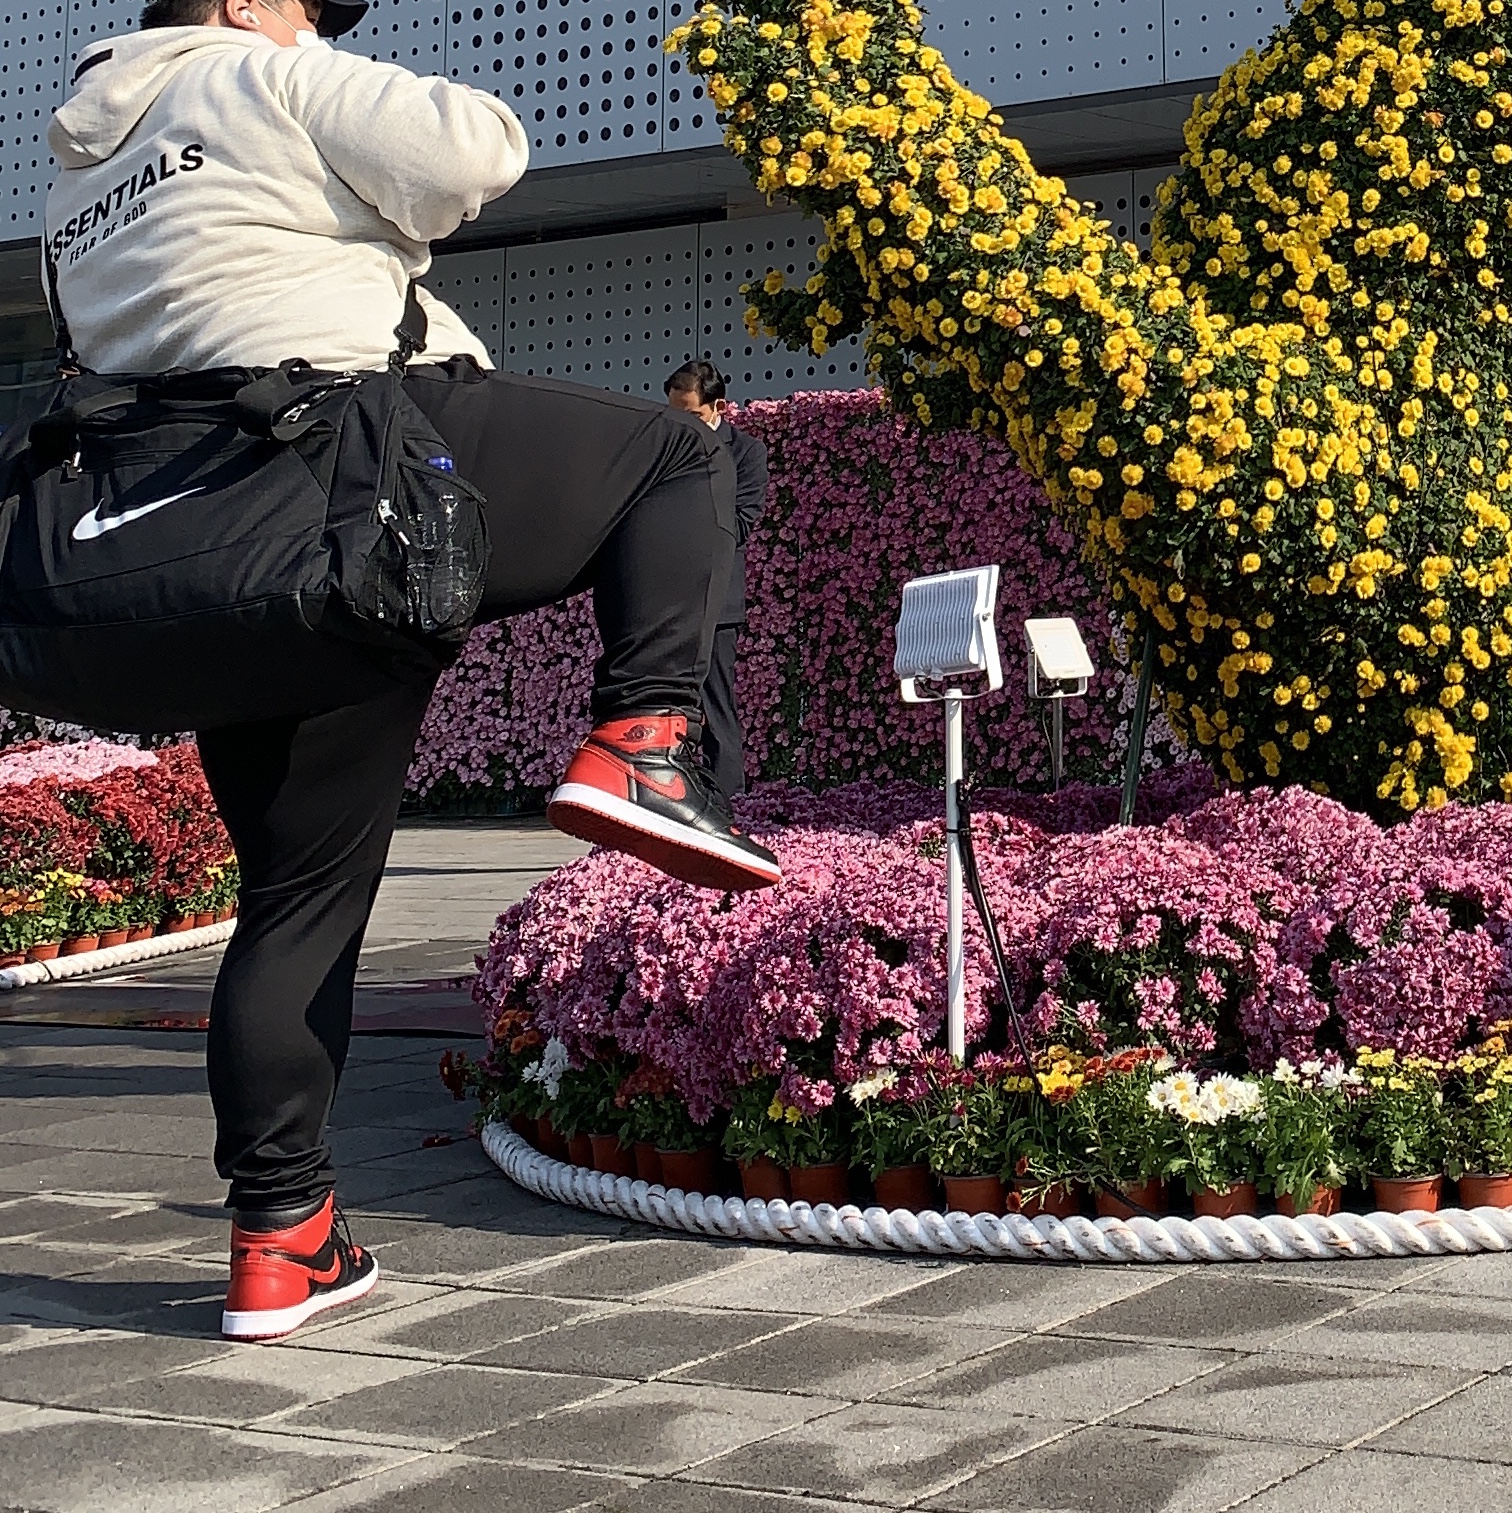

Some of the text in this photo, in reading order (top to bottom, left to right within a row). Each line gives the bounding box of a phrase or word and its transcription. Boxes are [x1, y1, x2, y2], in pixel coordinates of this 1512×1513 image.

[69, 200, 147, 266] FEAR OF GOD
